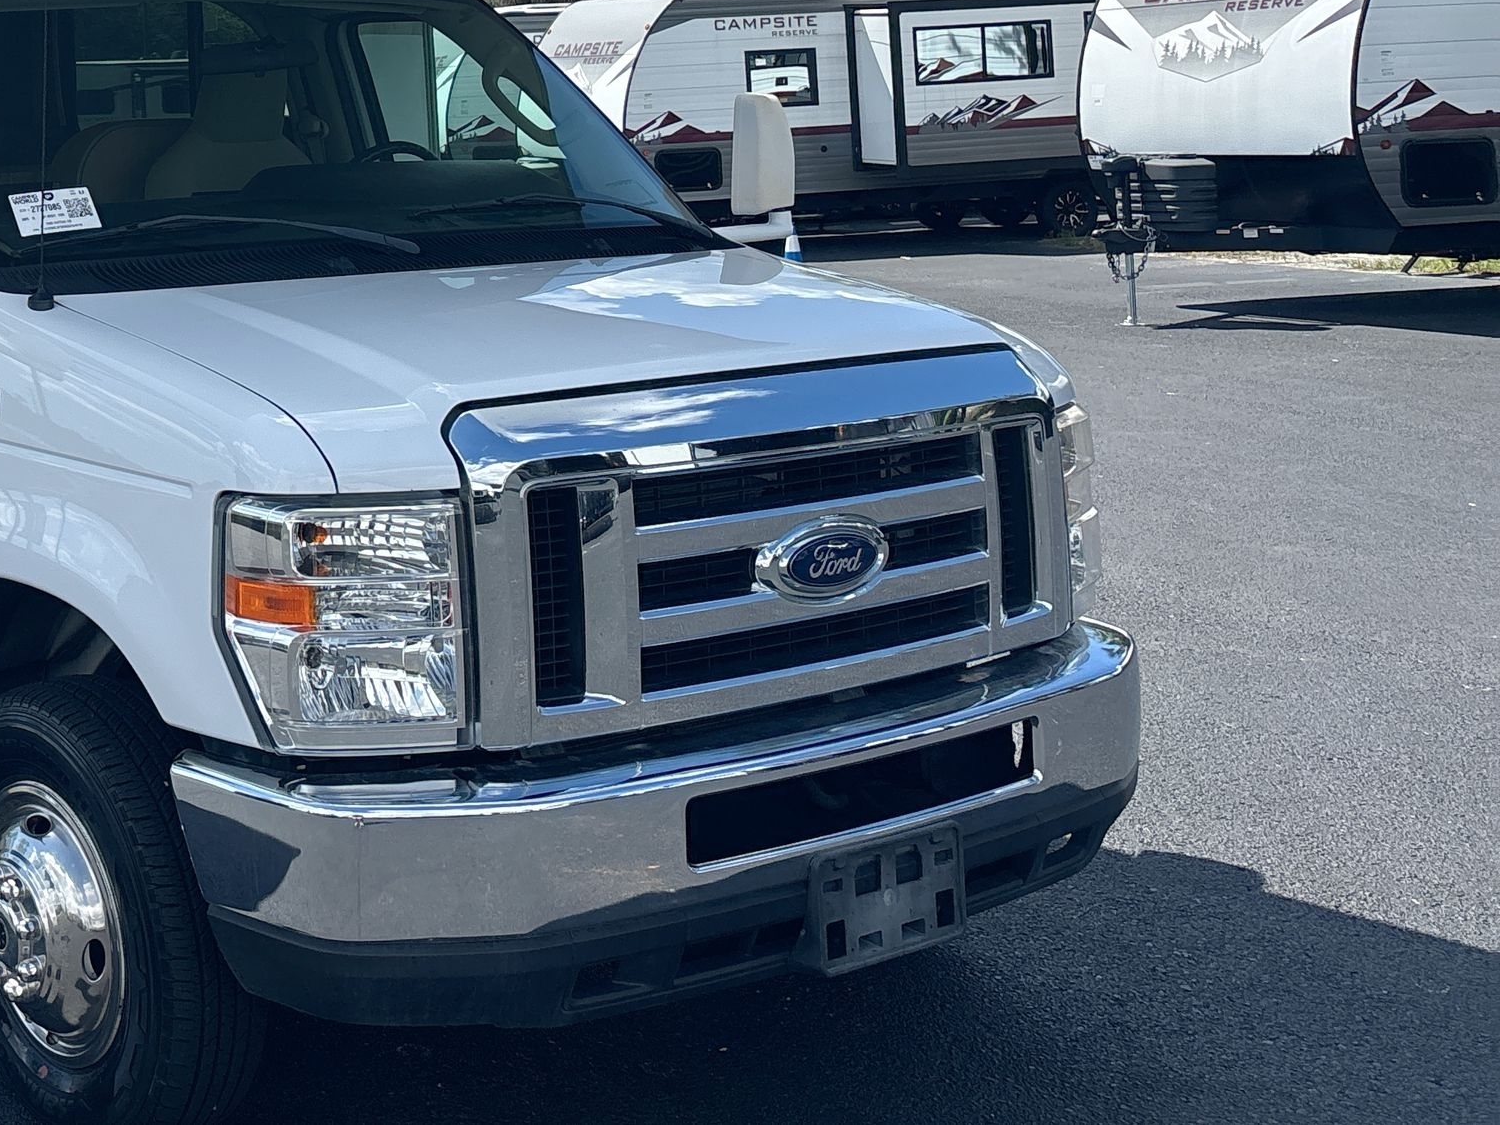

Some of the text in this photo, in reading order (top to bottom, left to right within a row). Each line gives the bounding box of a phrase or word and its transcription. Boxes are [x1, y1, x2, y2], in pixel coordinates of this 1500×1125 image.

[714, 15, 818, 31] CAMPSITE
[771, 28, 818, 37] RESERVE
[554, 41, 623, 57] CAMPSITE
[583, 57, 615, 65] RESERVE
[809, 542, 864, 579] Ford
